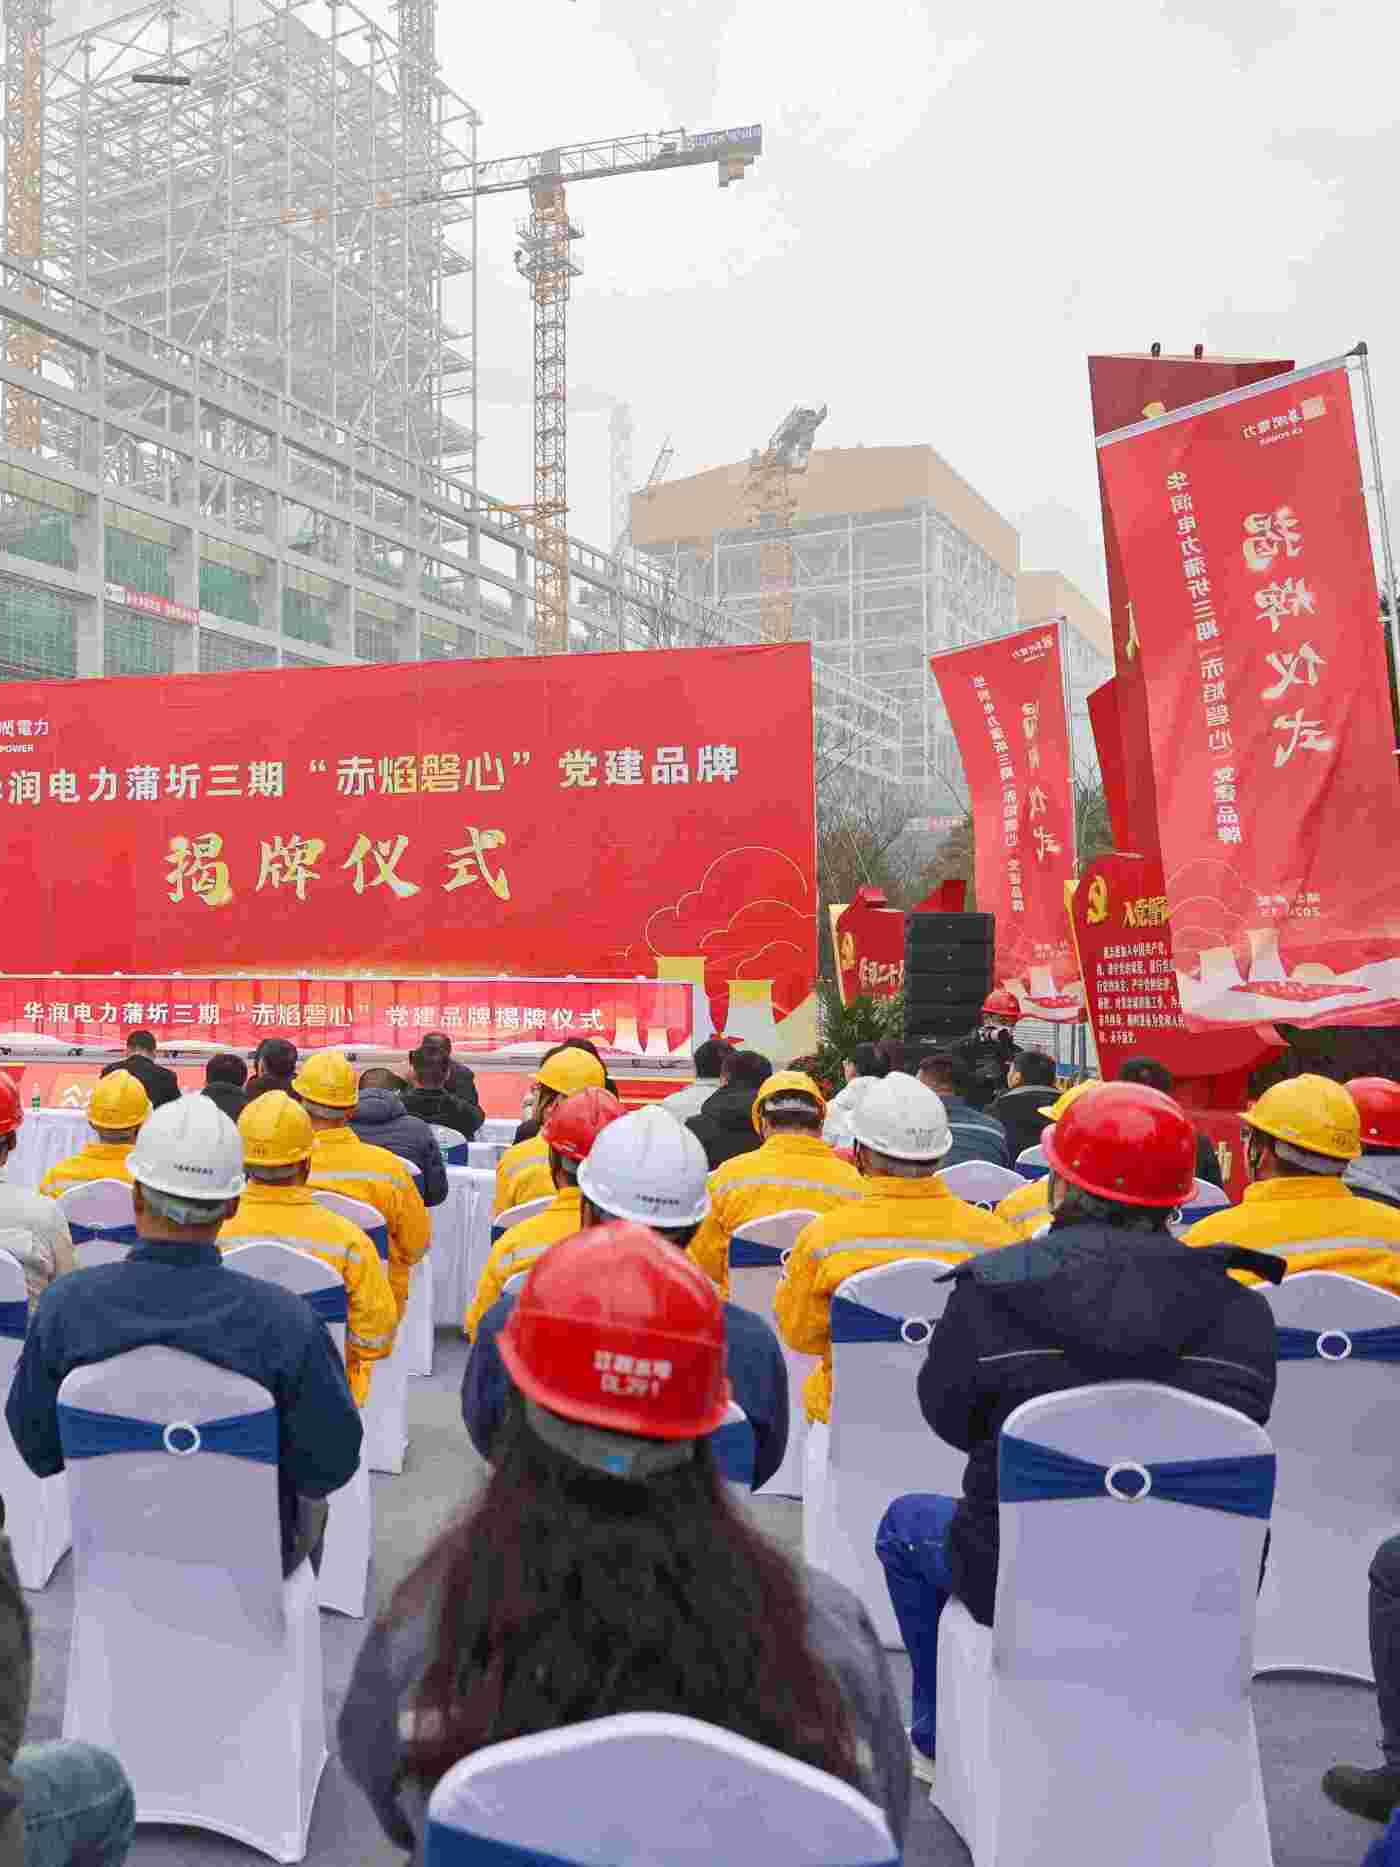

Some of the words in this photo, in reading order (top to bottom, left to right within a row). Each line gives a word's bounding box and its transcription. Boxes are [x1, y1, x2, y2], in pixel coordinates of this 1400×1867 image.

[0, 744, 35, 754] POWER
[164, 825, 512, 907] 揭牌仪式
